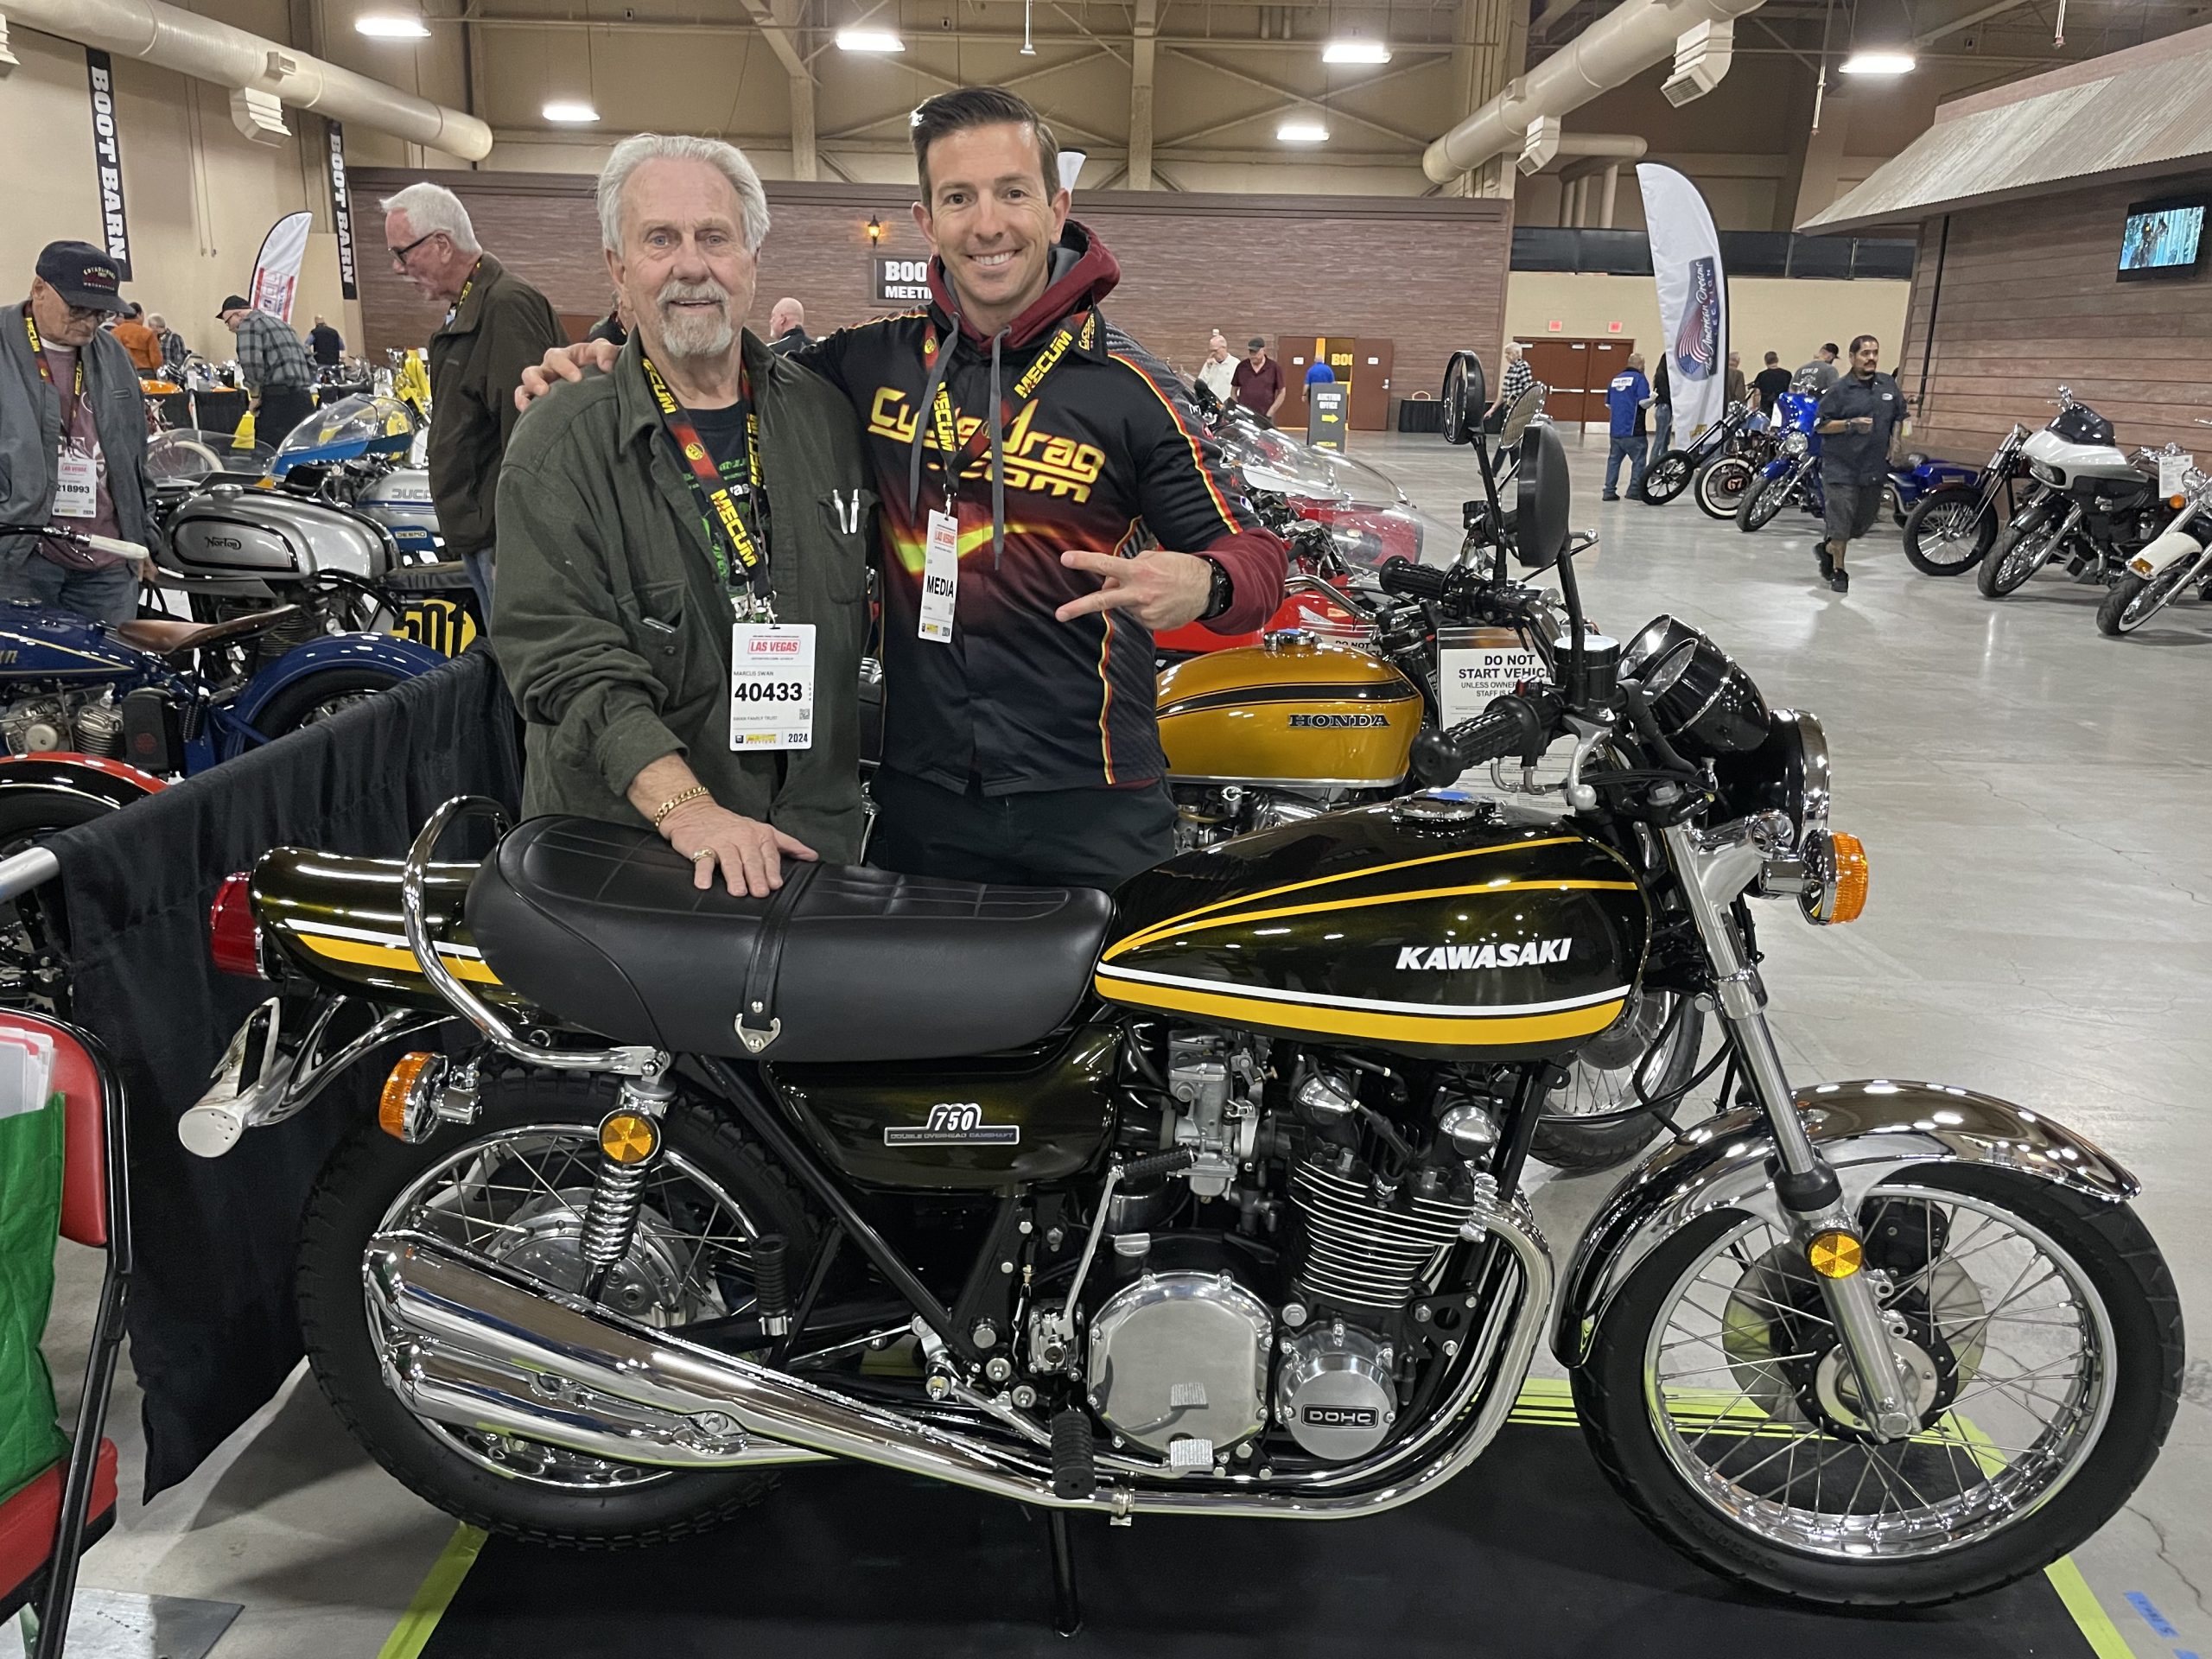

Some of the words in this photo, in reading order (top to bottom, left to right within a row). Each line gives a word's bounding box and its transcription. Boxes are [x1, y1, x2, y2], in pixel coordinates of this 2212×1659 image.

[91, 66, 117, 163] BOOT
[330, 133, 347, 208] BOOT
[101, 166, 127, 263] BARN
[336, 211, 355, 286] BARN
[1695, 261, 1708, 304] Dreams
[1700, 304, 1714, 355] American
[1014, 329, 1073, 399] MECUM
[1727, 478, 1744, 490] 67
[709, 488, 758, 569] MECUM
[926, 575, 954, 599] MEDIA
[750, 641, 768, 652] LAS
[770, 641, 798, 652] VEGAS
[1484, 655, 1503, 666] DO
[1506, 654, 1536, 666] NOT
[1459, 668, 1501, 679] START
[734, 682, 803, 702] 40433
[1288, 714, 1391, 728] HONDA
[787, 733, 809, 743] 2024
[1395, 938, 1573, 970] KAWASAKI
[934, 1111, 975, 1132] 750
[1309, 1410, 1372, 1424] DOHC
